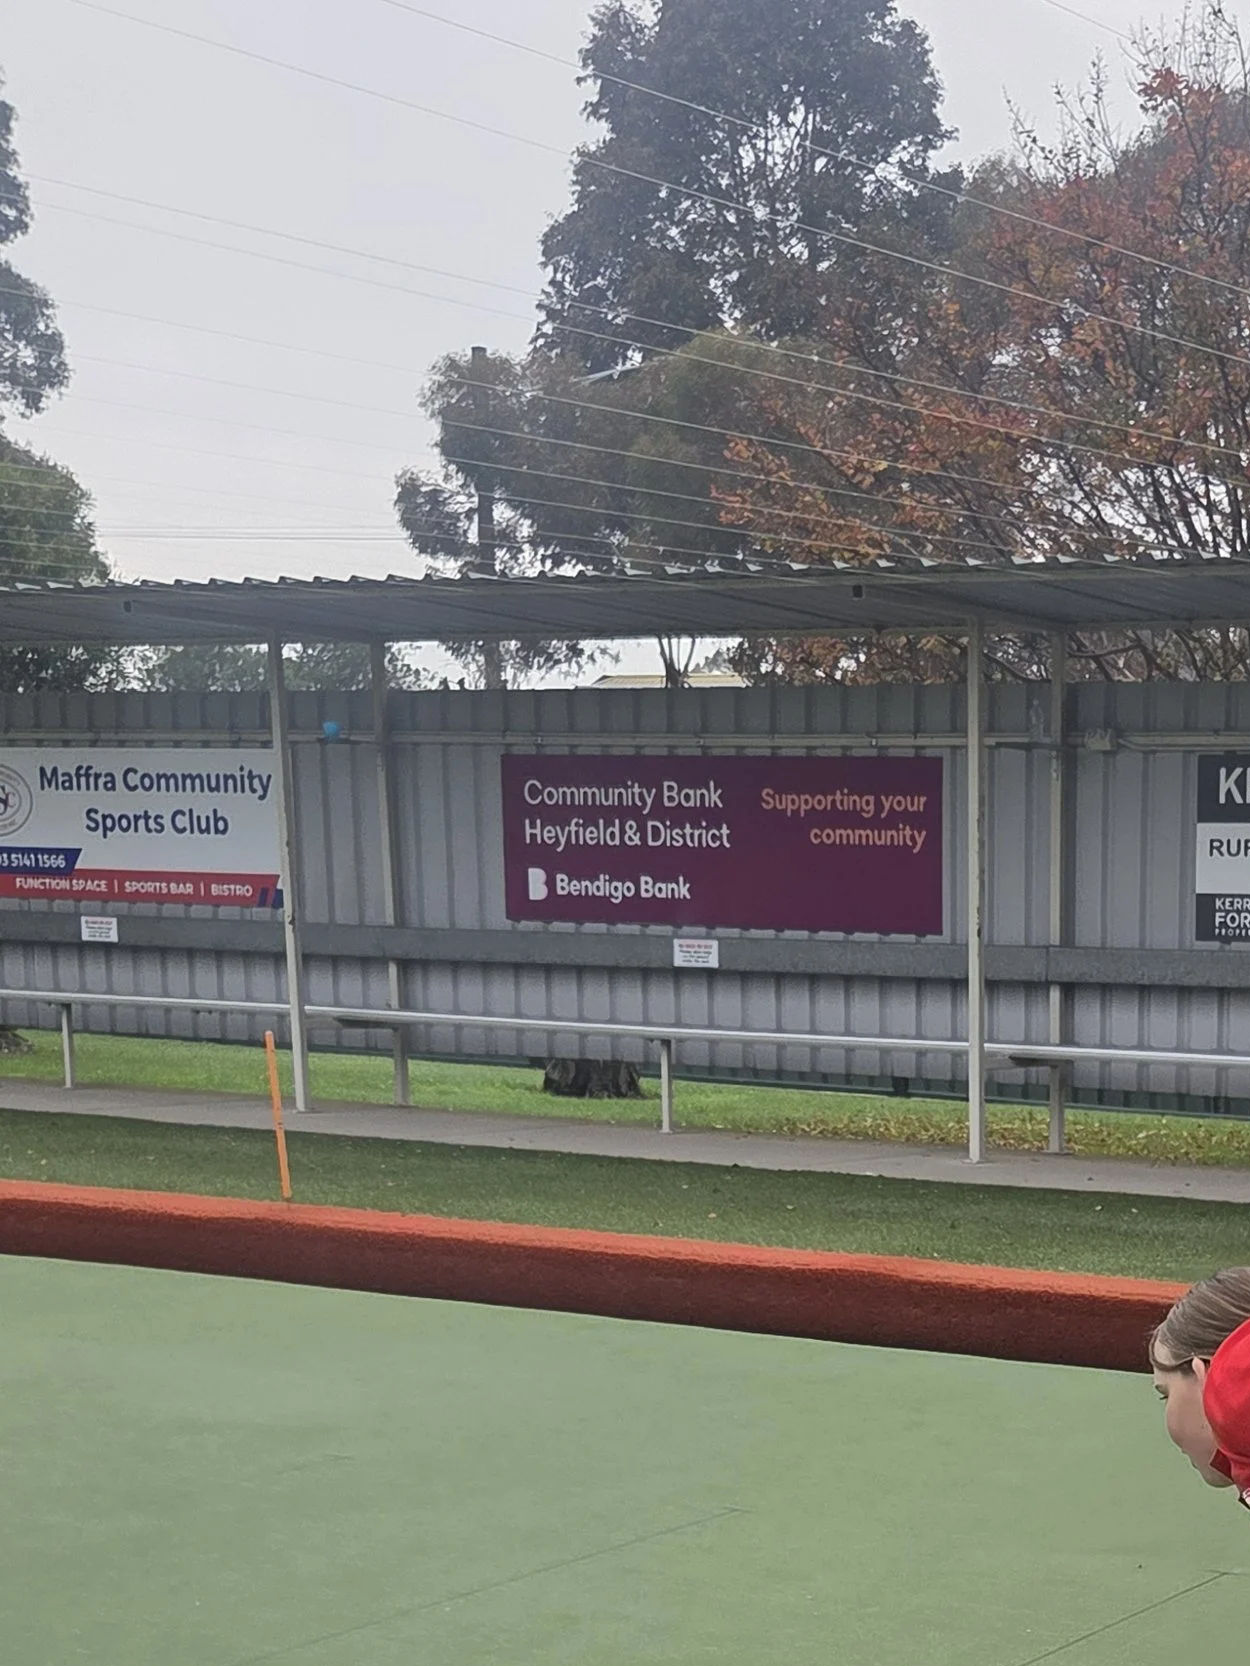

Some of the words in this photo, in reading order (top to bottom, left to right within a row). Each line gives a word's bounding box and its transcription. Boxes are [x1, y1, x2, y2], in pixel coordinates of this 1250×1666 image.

[39, 765, 117, 791] Maffra
[123, 765, 271, 800] Community
[524, 780, 656, 814] Community
[663, 781, 723, 807] Bank
[761, 788, 874, 817] Supporting
[881, 796, 927, 818] your
[86, 808, 164, 838] Sports
[171, 808, 228, 835] Club
[525, 818, 620, 852] Heyfield
[624, 820, 641, 845] &
[647, 820, 730, 848] District
[810, 824, 926, 853] community
[11, 854, 35, 866] 5141
[37, 854, 65, 868] 1566
[16, 878, 70, 889] FUNCTION
[72, 879, 107, 891] SPACE
[125, 881, 168, 893] SPORTS
[170, 883, 193, 894] BAR
[211, 884, 252, 896] BISTRO
[556, 874, 635, 903] Bendigo
[640, 876, 690, 899] Bank
